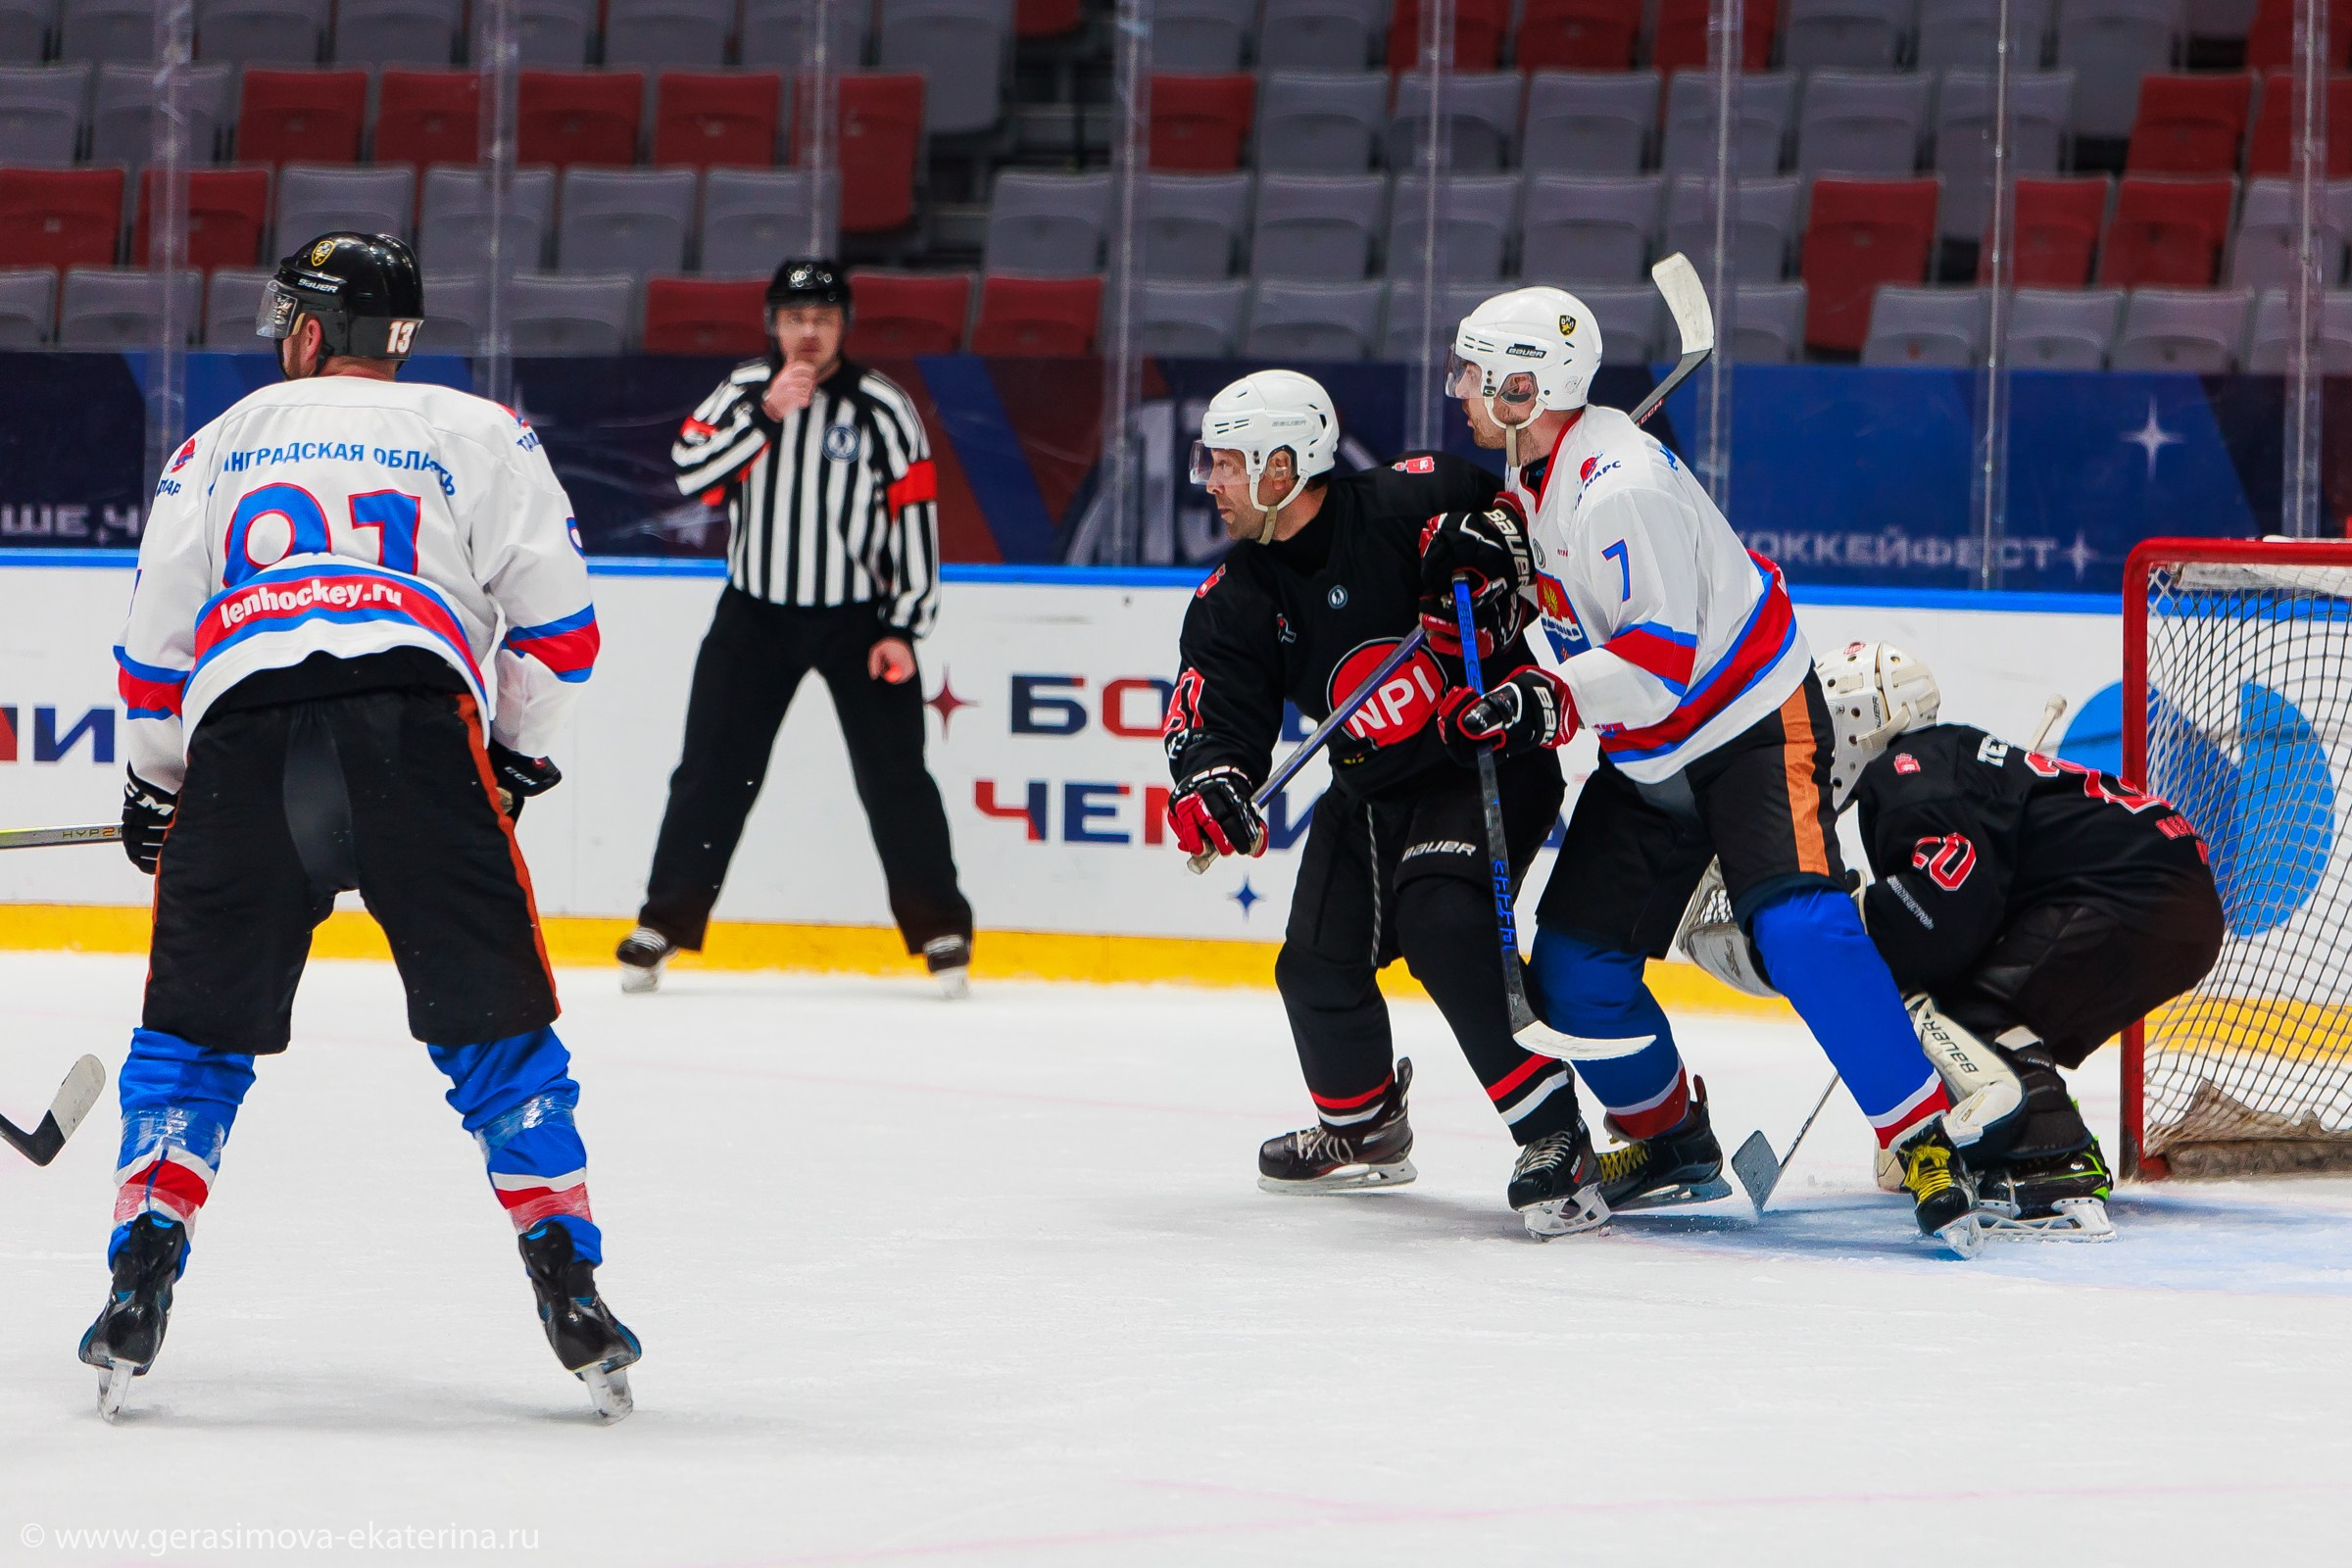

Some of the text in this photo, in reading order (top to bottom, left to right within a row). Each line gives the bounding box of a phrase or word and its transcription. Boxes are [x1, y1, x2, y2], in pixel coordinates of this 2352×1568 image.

[386, 320, 416, 355] 13
[222, 481, 421, 589] 91
[1737, 525, 2057, 571] ОККЕЙФЕСТ
[1601, 538, 1631, 602] 7
[220, 579, 403, 628] lenhockey.ru
[1348, 664, 1436, 739] NPI
[1401, 840, 1477, 863] BAUER
